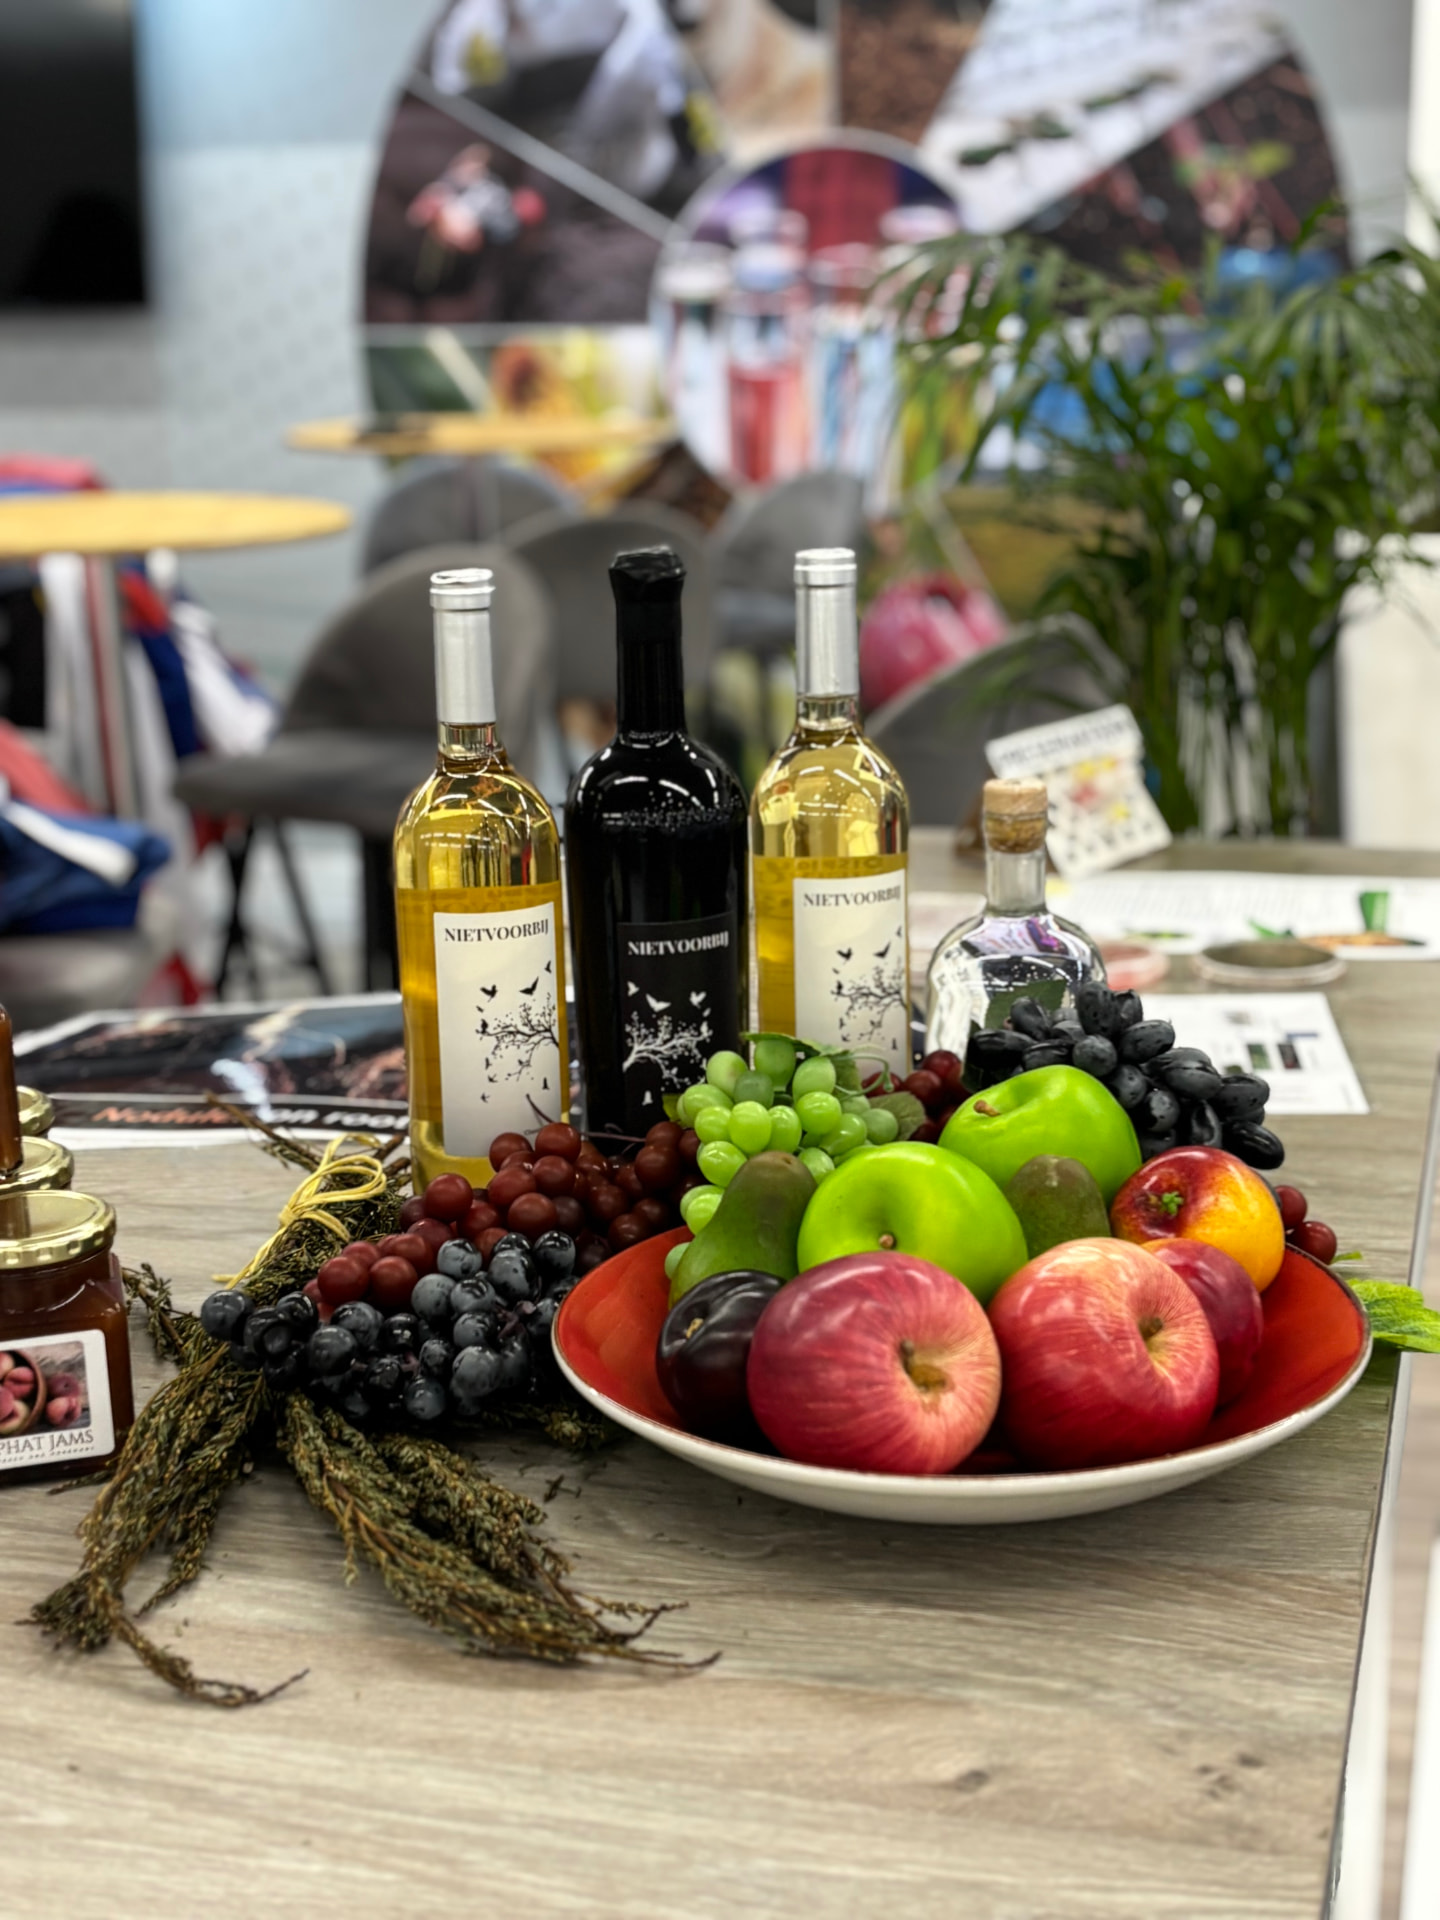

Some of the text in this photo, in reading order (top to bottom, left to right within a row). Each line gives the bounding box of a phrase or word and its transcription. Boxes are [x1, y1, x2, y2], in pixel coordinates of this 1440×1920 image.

[803, 885, 901, 907] NIETVOORBIJ
[444, 918, 549, 942] NIETVOORBIJ
[627, 930, 729, 956] NIETVOORBIJ
[92, 1106, 250, 1125] Nodule
[49, 1428, 94, 1452] JAMS
